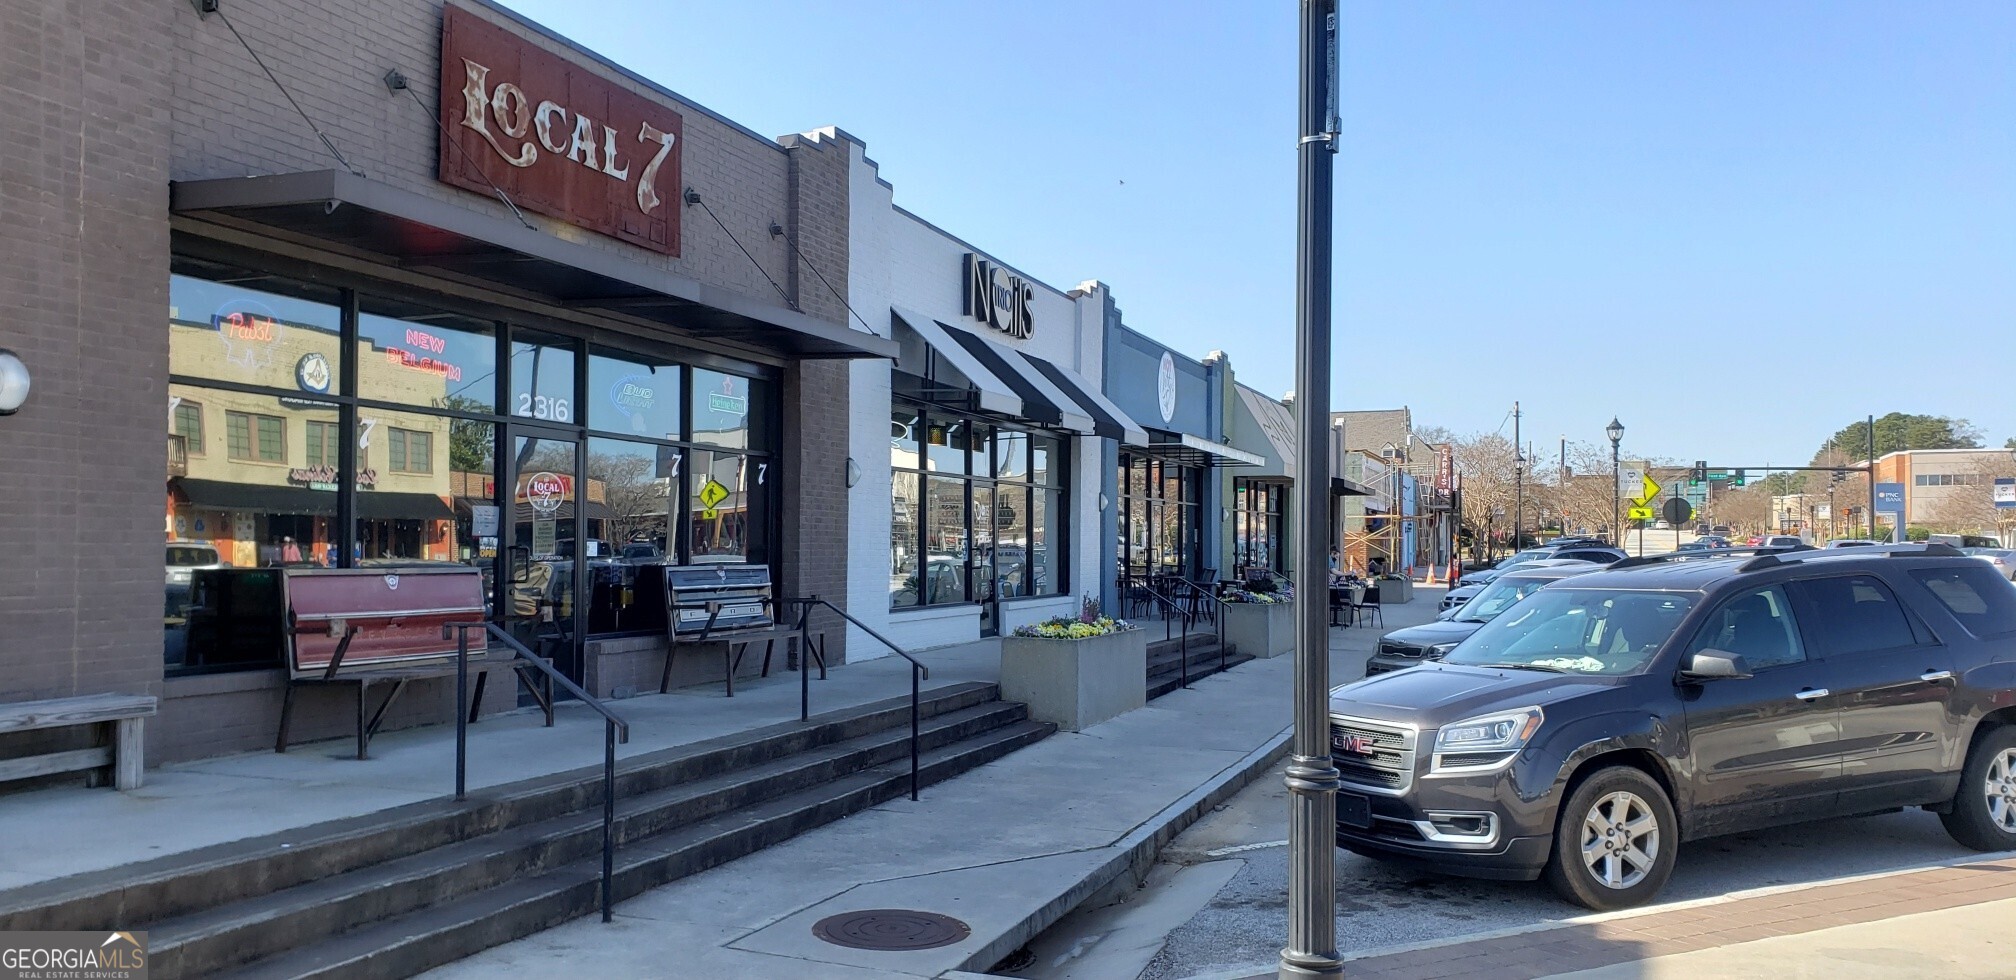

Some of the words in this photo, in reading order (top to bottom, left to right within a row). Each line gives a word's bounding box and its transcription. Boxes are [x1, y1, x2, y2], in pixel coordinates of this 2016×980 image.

[460, 56, 631, 182] LOCAL
[637, 121, 675, 215] 7
[227, 312, 272, 341] Pabst
[406, 328, 445, 354] NEW
[386, 346, 461, 382] BELGIUM
[518, 392, 569, 421] 2316
[360, 417, 377, 450] 7
[671, 453, 682, 478] 7
[758, 463, 767, 485] 7
[533, 481, 560, 495] LOCAL
[542, 491, 552, 507] 7
[1333, 735, 1373, 755] GMC
